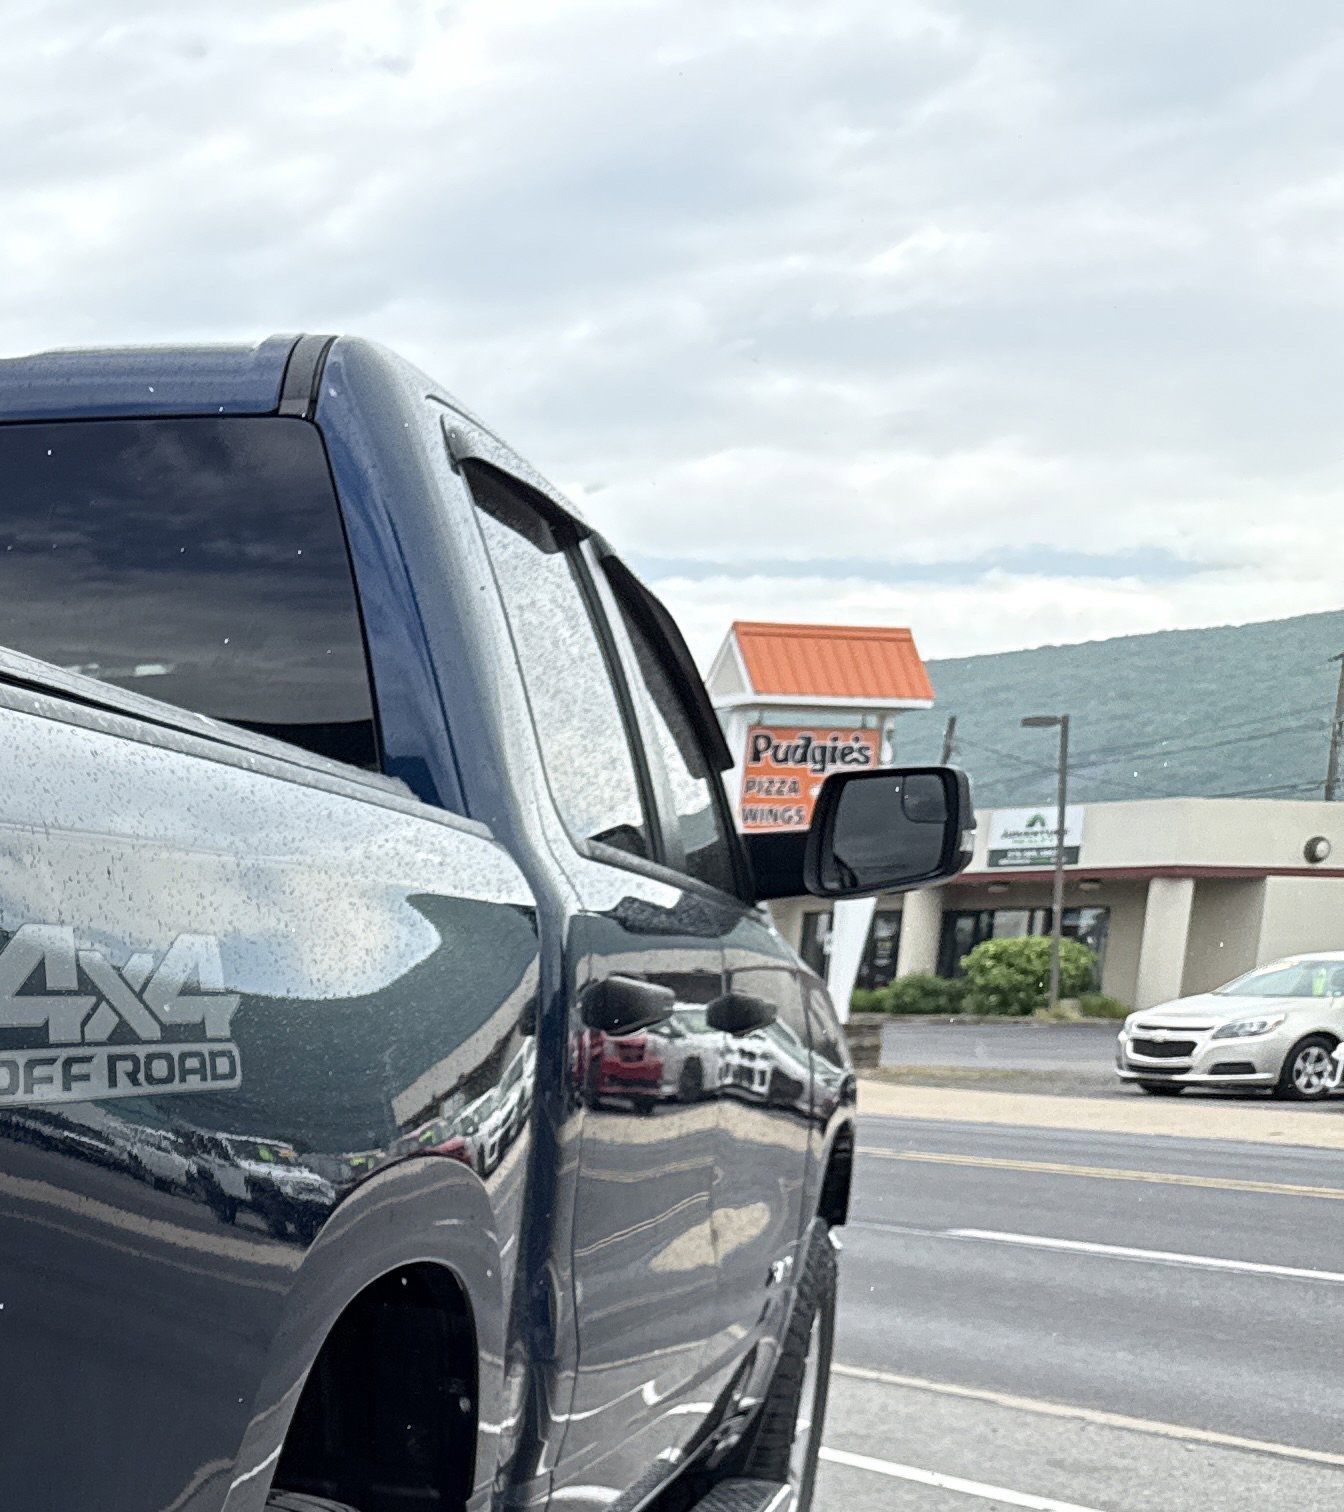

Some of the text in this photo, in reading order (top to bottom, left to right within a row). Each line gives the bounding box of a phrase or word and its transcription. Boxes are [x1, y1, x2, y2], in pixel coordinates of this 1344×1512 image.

[749, 733, 871, 773] Pudgie's
[745, 779, 800, 796] PIZZA
[742, 806, 805, 825] WINGS
[107, 1050, 238, 1088] ROAD
